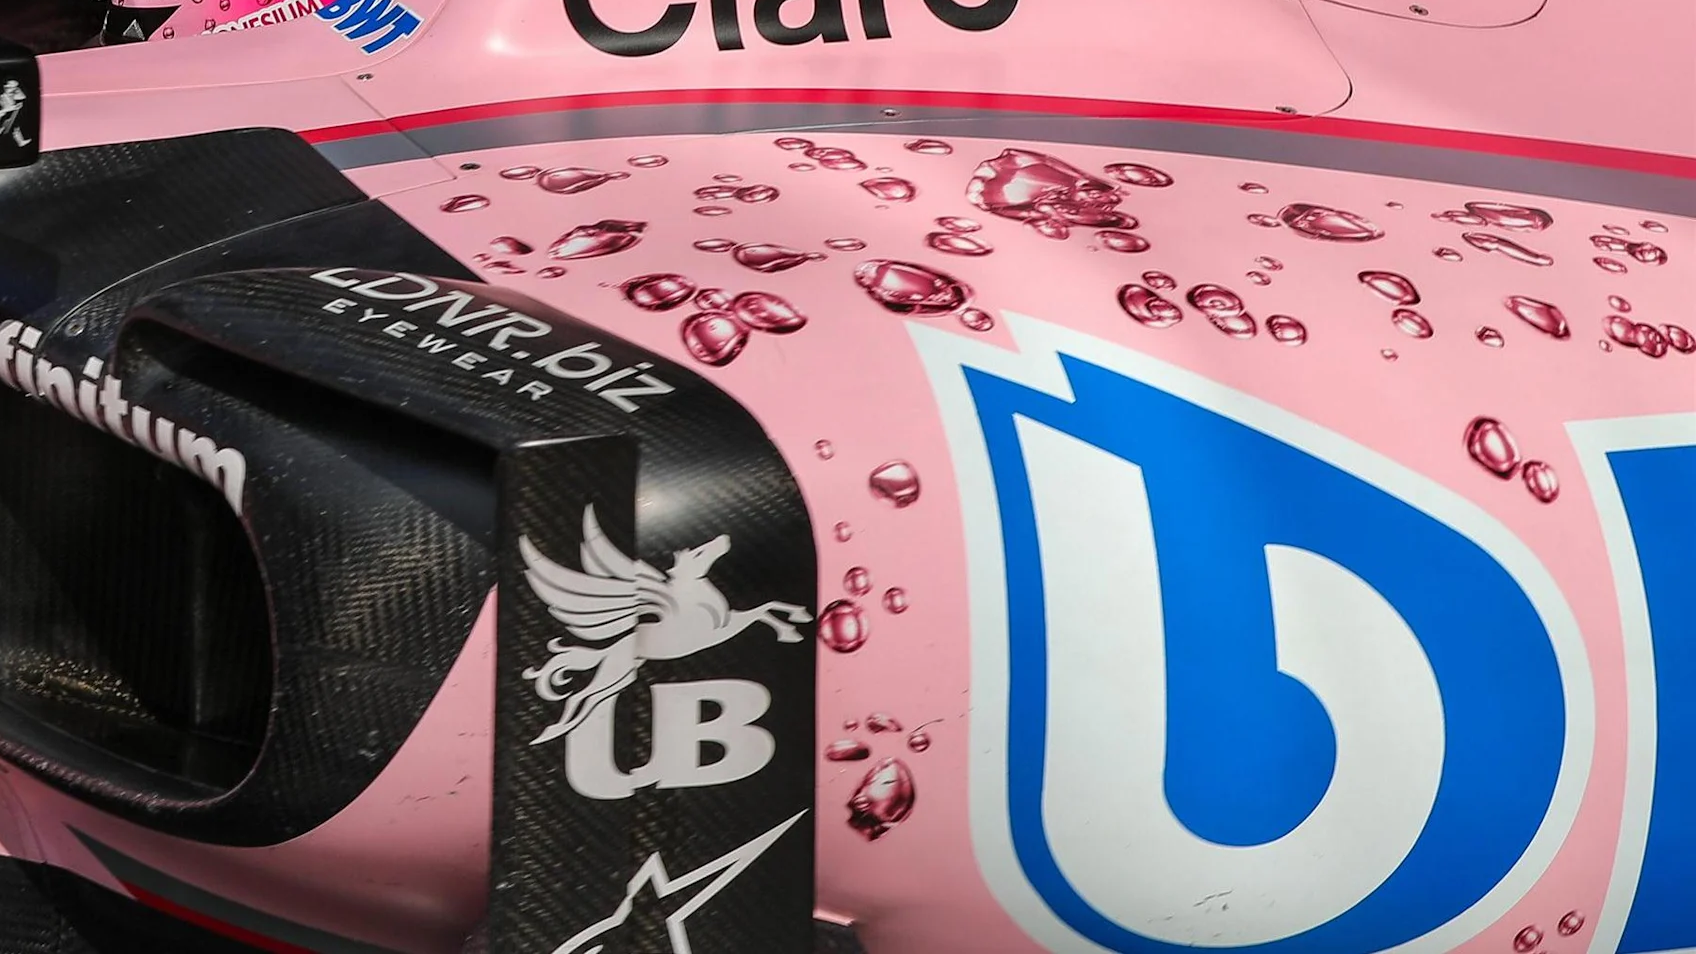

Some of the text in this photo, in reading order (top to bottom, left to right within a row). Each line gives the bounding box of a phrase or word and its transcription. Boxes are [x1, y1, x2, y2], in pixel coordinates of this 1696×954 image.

[310, 267, 676, 414] LDNR.biz
[322, 297, 555, 401] EYEWEAR
[564, 678, 777, 800] UB
